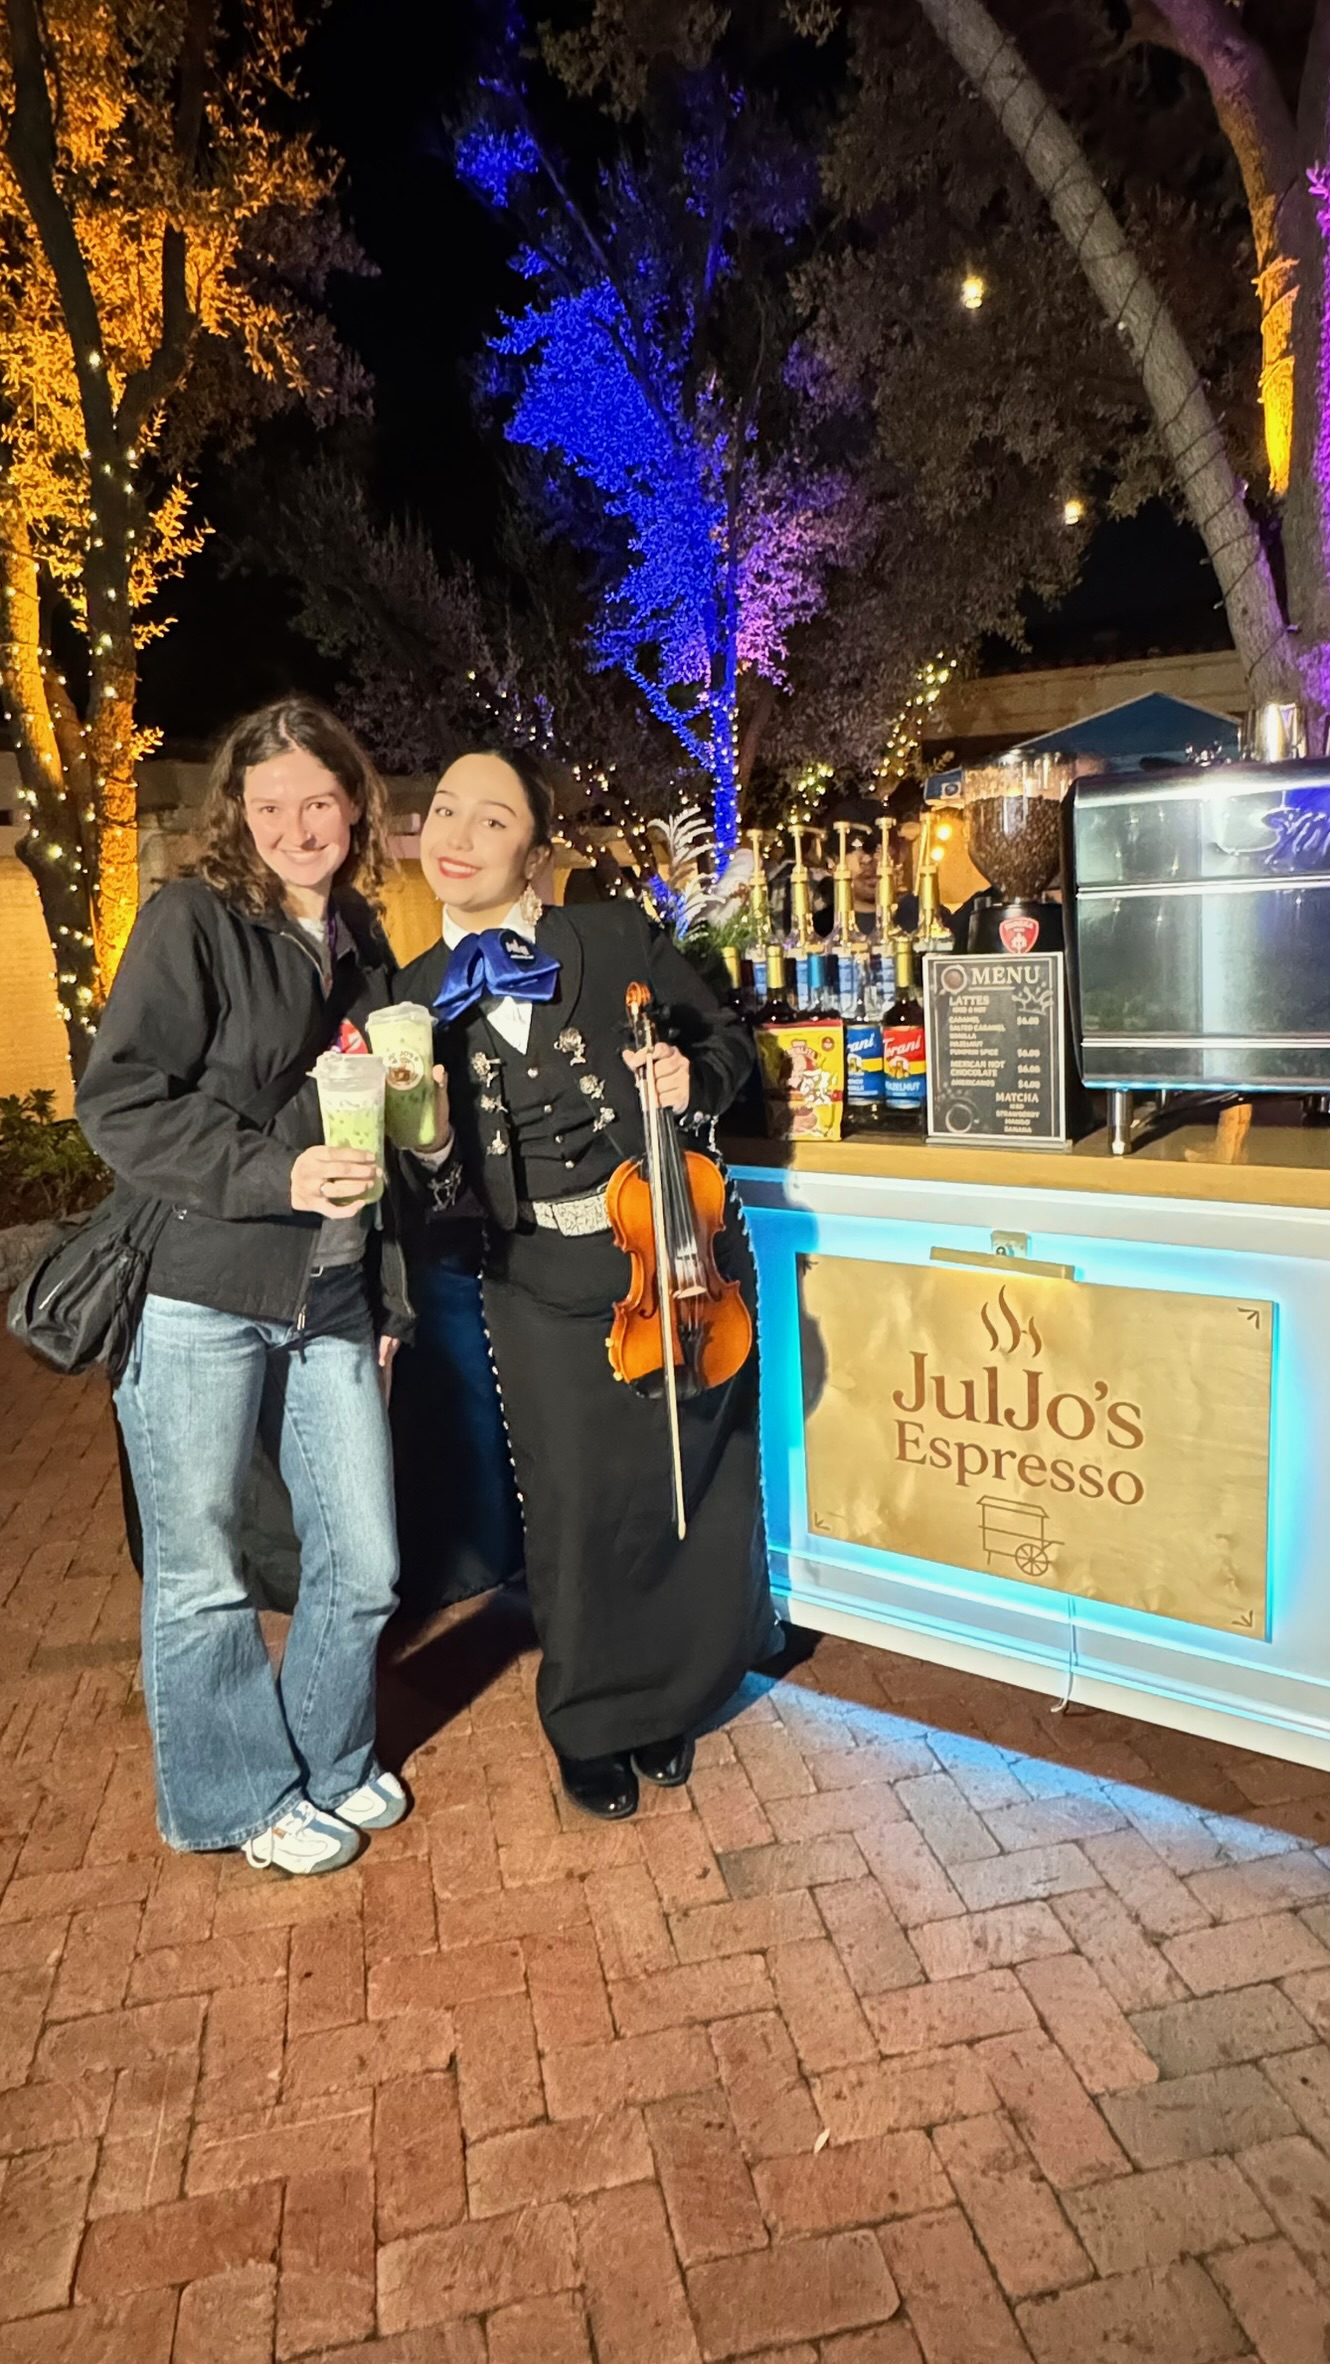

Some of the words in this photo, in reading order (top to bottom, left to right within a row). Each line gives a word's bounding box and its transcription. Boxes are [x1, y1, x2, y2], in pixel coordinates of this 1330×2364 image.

[971, 965, 1040, 985] MENU
[949, 995, 990, 1006] LATTES
[847, 1032, 875, 1052] rani
[950, 1060, 987, 1068] MEXICAN
[988, 1060, 1006, 1069] HOT
[950, 1069, 998, 1077] CHOCOLATE
[996, 1092, 1039, 1103] MATCHA
[892, 1350, 1145, 1450] JulJo's
[893, 1419, 1145, 1505] Espresso
